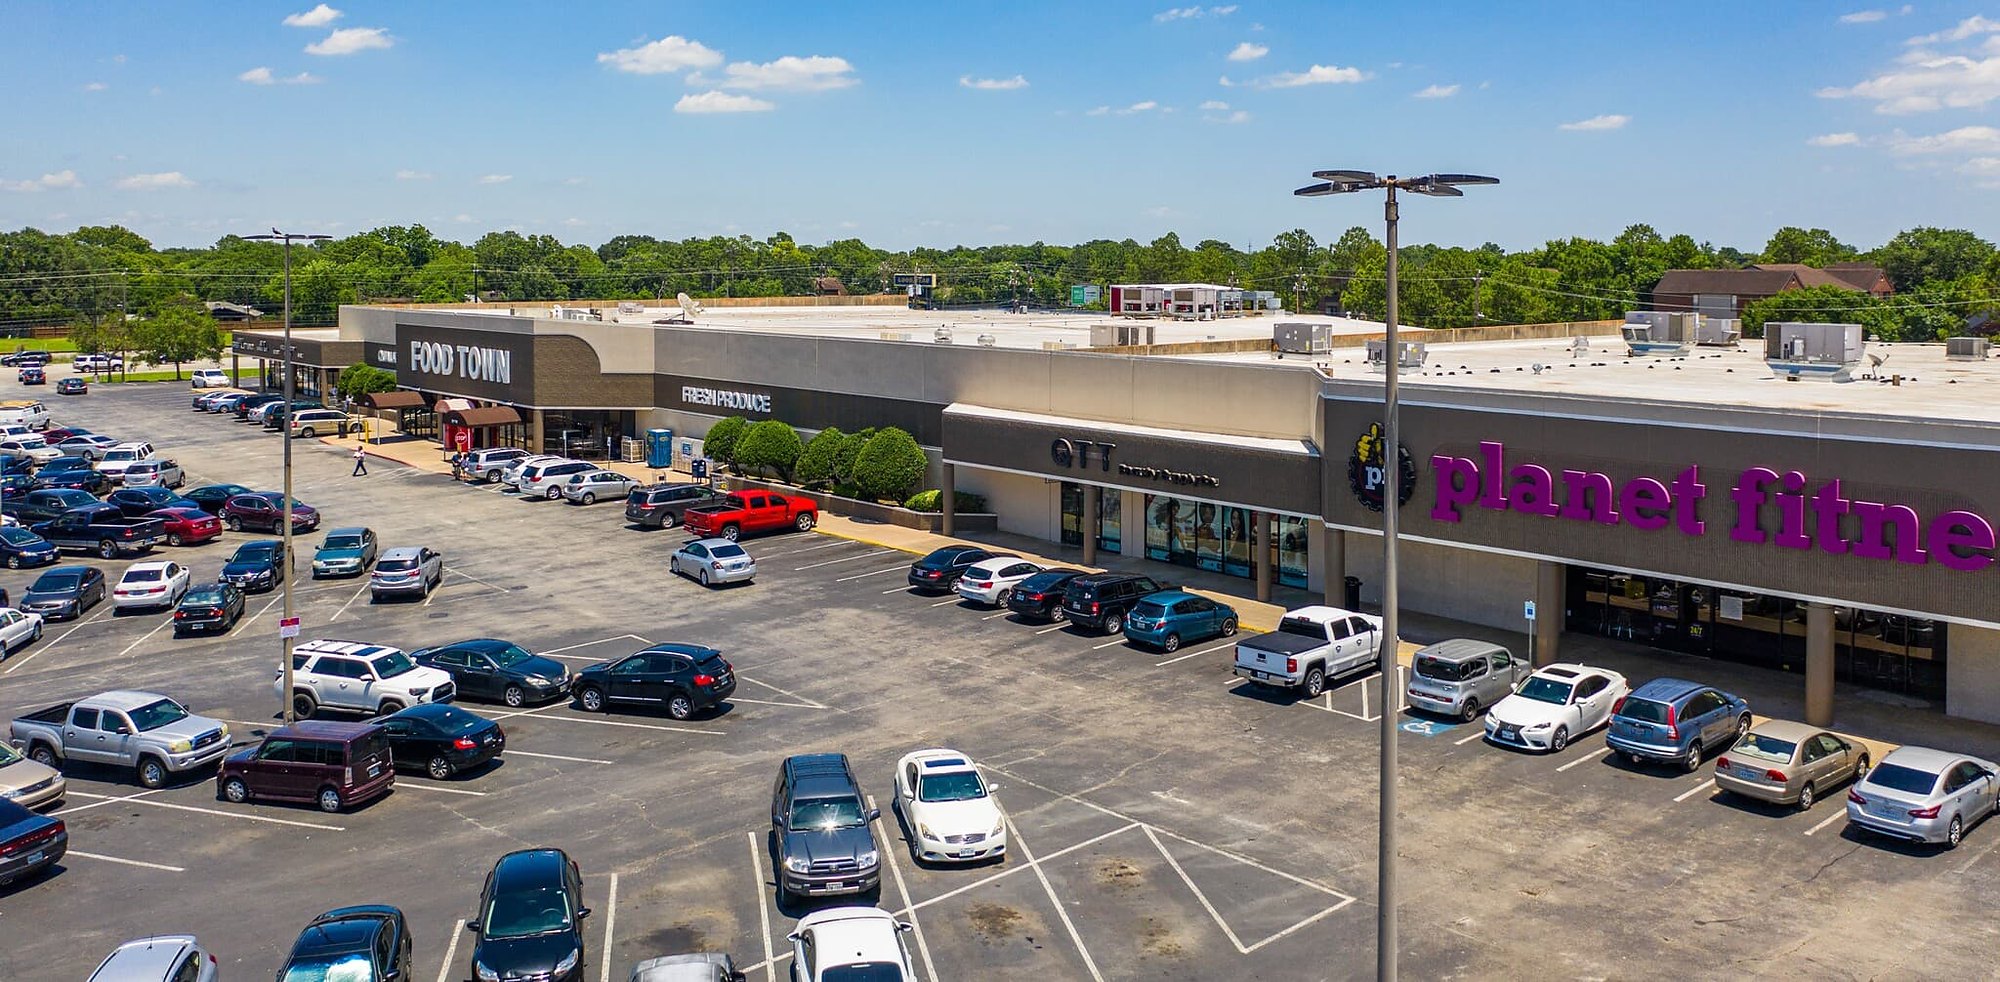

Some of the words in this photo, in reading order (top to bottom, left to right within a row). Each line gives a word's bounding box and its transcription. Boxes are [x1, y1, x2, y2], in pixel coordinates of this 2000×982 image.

[411, 341, 454, 375] FOOD
[457, 346, 510, 384] TOWN
[682, 386, 716, 406] FRESH
[717, 390, 771, 413] PRODUCE
[1365, 465, 1385, 490] p
[1430, 440, 1705, 536] planet
[1730, 467, 2000, 571] fitne
